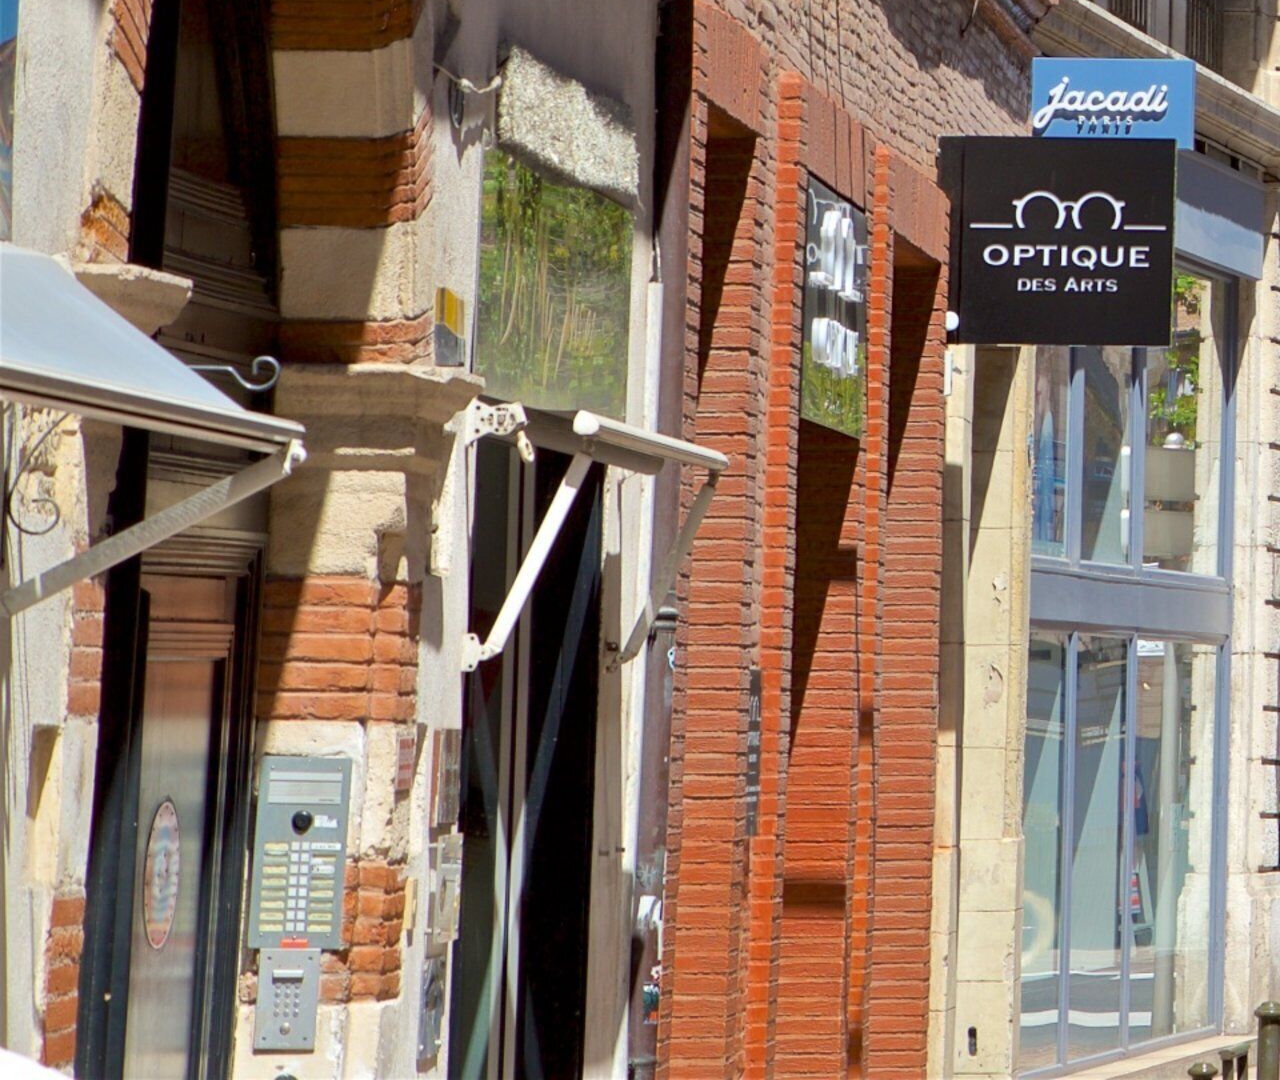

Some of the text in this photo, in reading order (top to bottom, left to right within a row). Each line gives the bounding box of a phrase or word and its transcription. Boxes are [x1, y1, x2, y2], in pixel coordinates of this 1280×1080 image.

[1032, 76, 1168, 130] jacadi
[1077, 114, 1134, 126] PARIS
[982, 243, 1151, 271] OPTIQUE
[1017, 276, 1119, 293] DES ARTS
